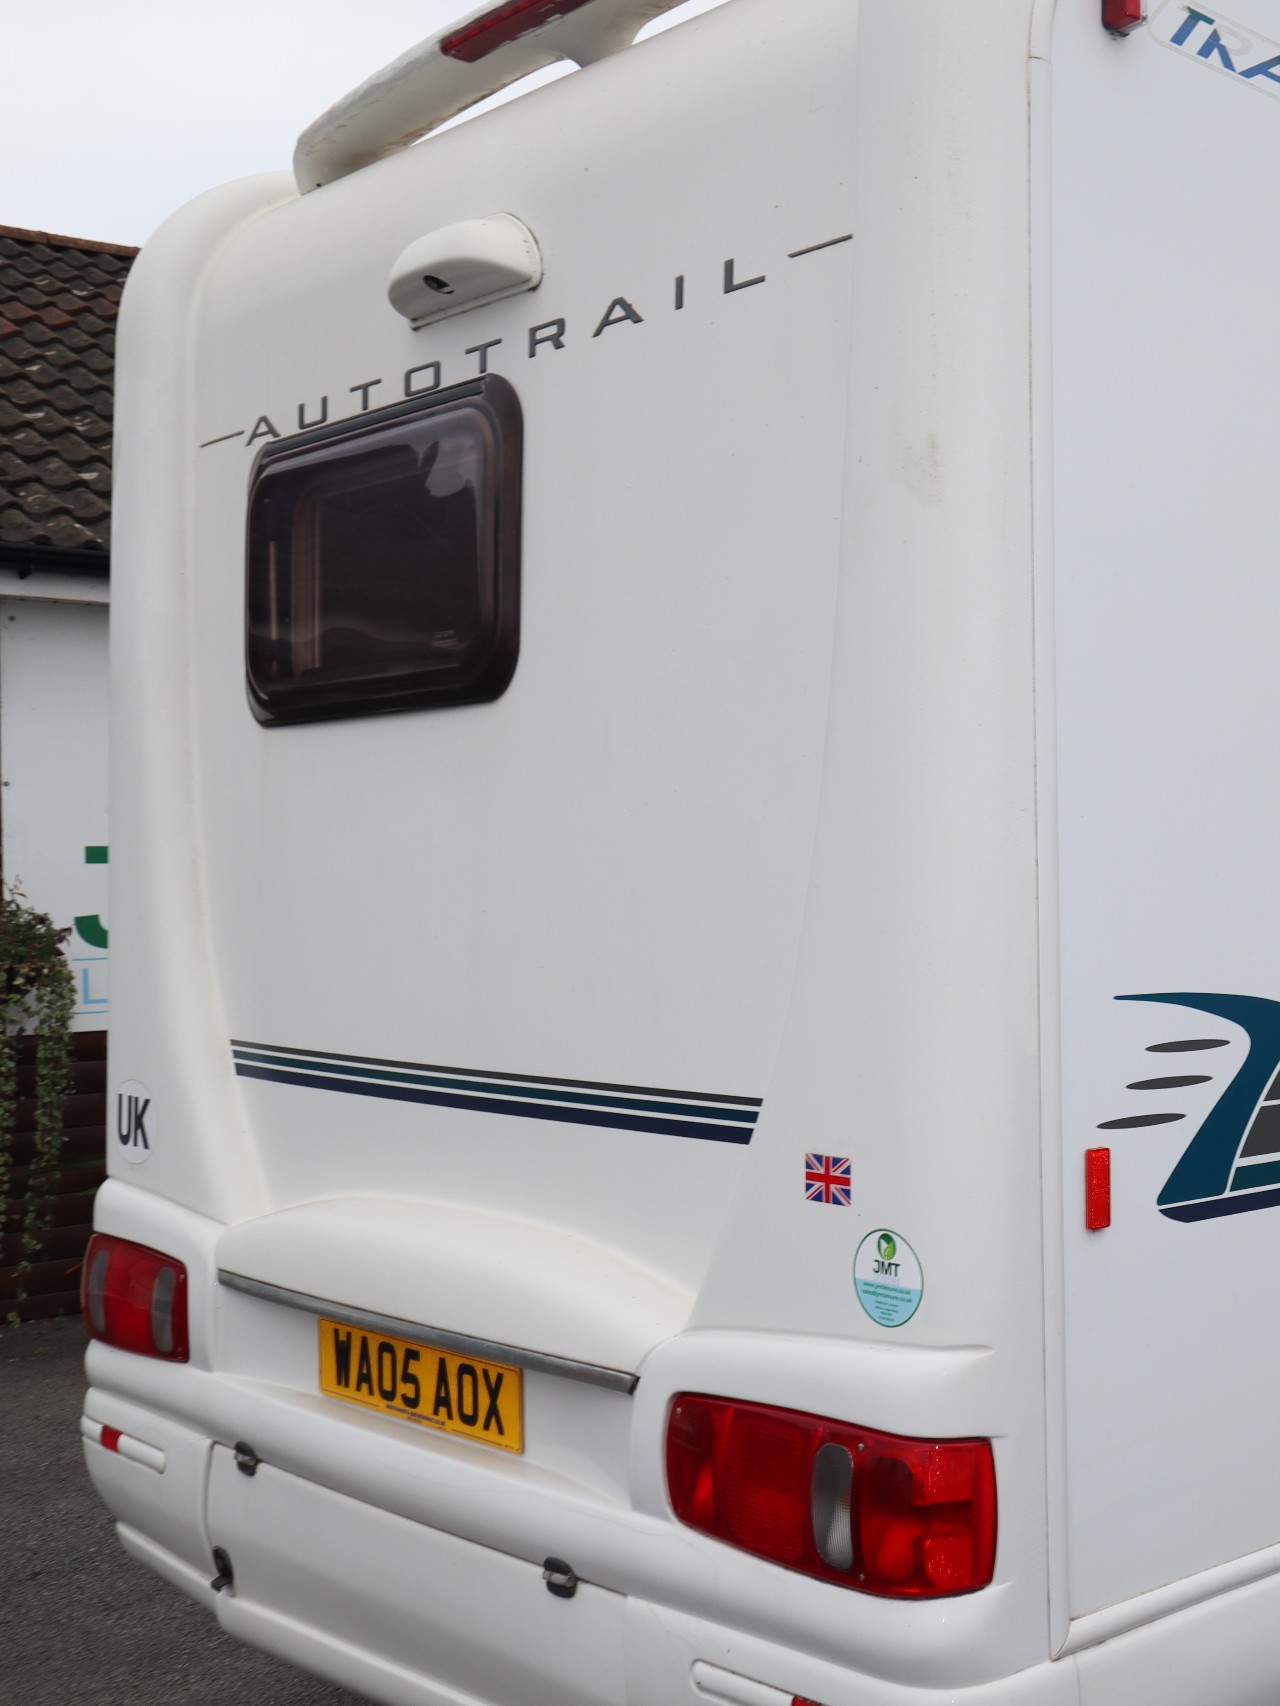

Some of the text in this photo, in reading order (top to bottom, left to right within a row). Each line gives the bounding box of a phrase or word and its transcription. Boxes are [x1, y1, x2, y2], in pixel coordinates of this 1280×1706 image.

[245, 257, 766, 447] AUTOTRAIL
[117, 1093, 151, 1150] UK
[872, 1259, 901, 1277] JMT
[333, 1327, 505, 1436] WA05 AOX
